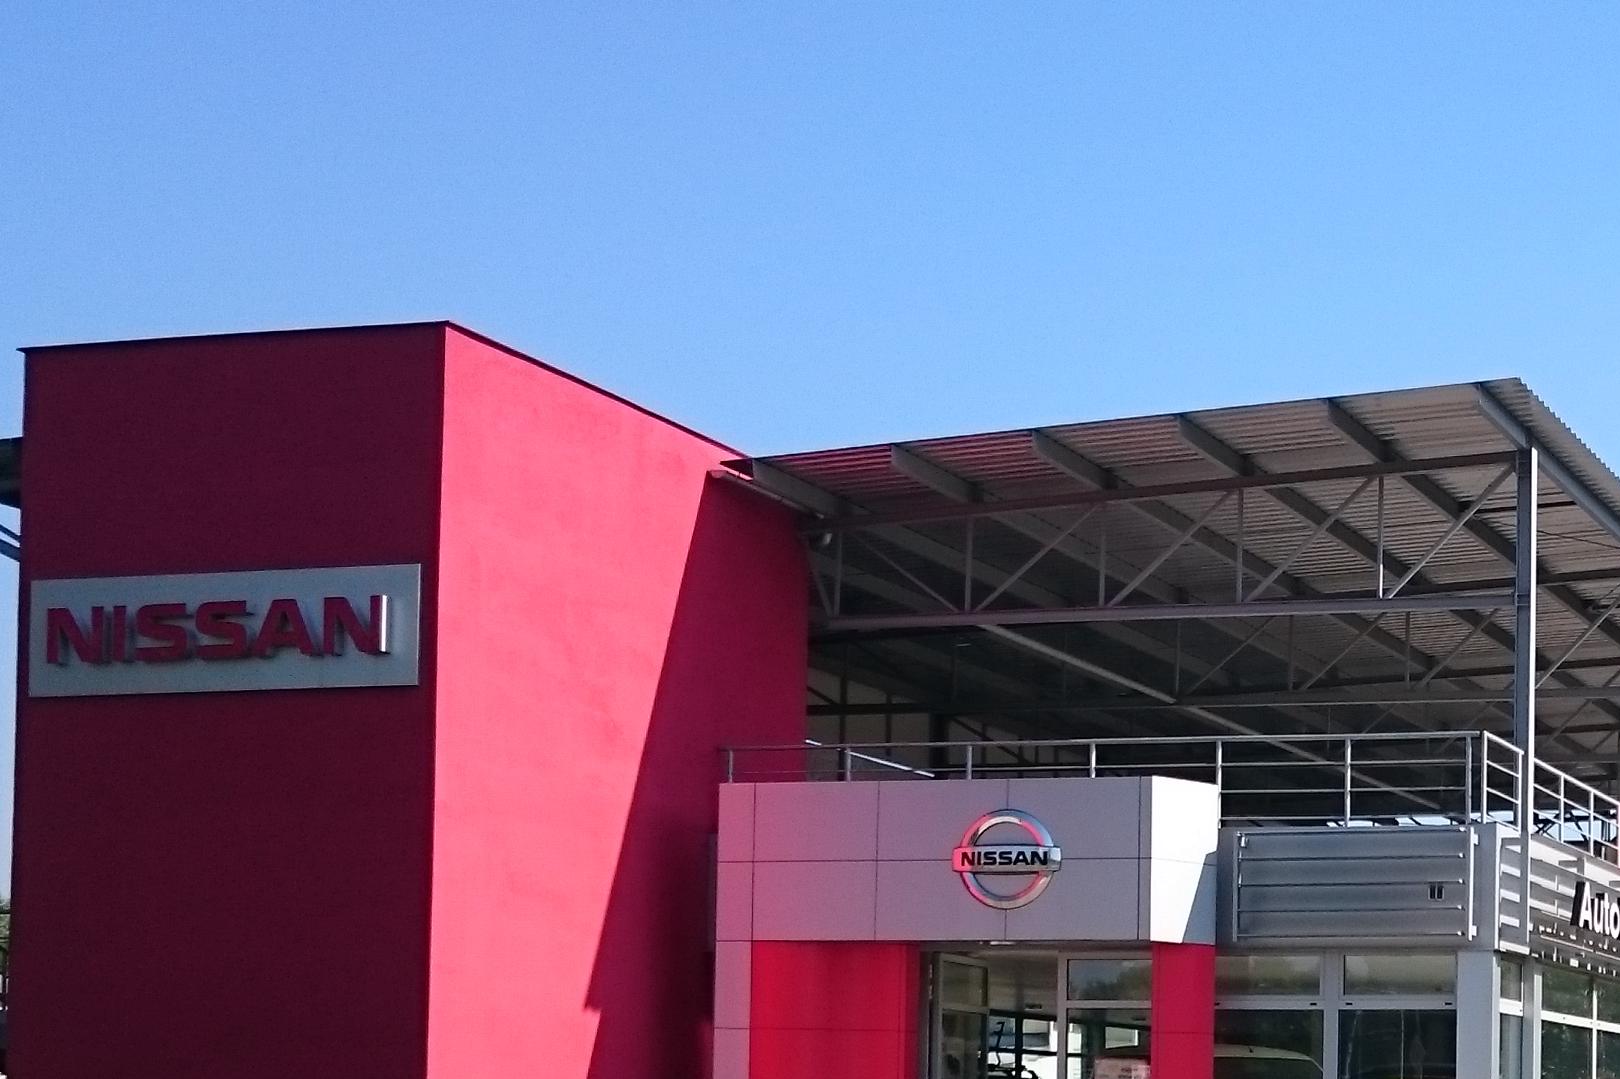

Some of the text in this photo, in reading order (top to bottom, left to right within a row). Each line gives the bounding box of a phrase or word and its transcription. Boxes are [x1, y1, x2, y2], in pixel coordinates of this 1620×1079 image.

[46, 594, 390, 666] NISSAN
[960, 850, 1049, 867] NISSAN
[1578, 881, 1620, 940] Auto
